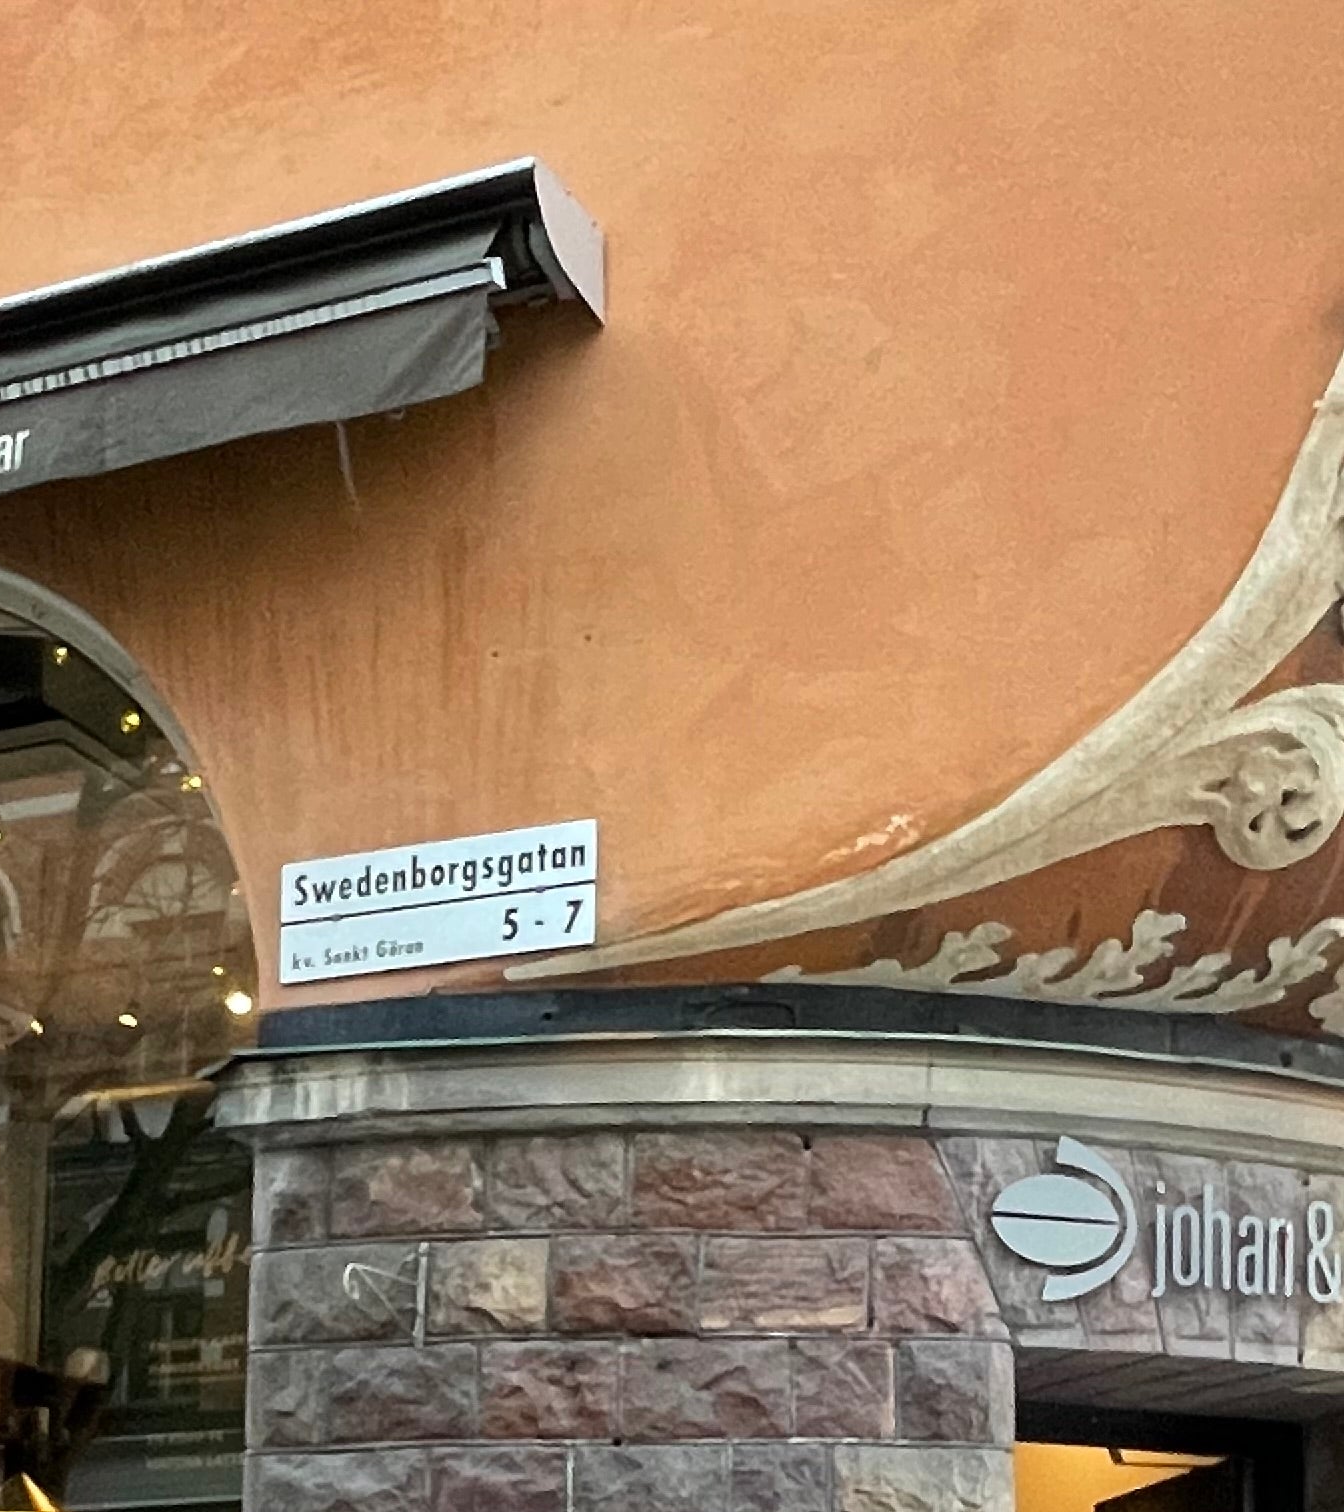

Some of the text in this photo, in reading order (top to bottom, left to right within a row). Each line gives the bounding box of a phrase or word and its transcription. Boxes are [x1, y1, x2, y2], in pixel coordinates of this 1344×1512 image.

[294, 844, 586, 906] Swedenborgsgatan
[502, 907, 519, 941] 5
[563, 899, 585, 934] 7
[324, 944, 368, 966] Sankt
[376, 939, 424, 957] Göran
[1151, 1180, 1294, 1298] johan
[1306, 1200, 1342, 1303] &
